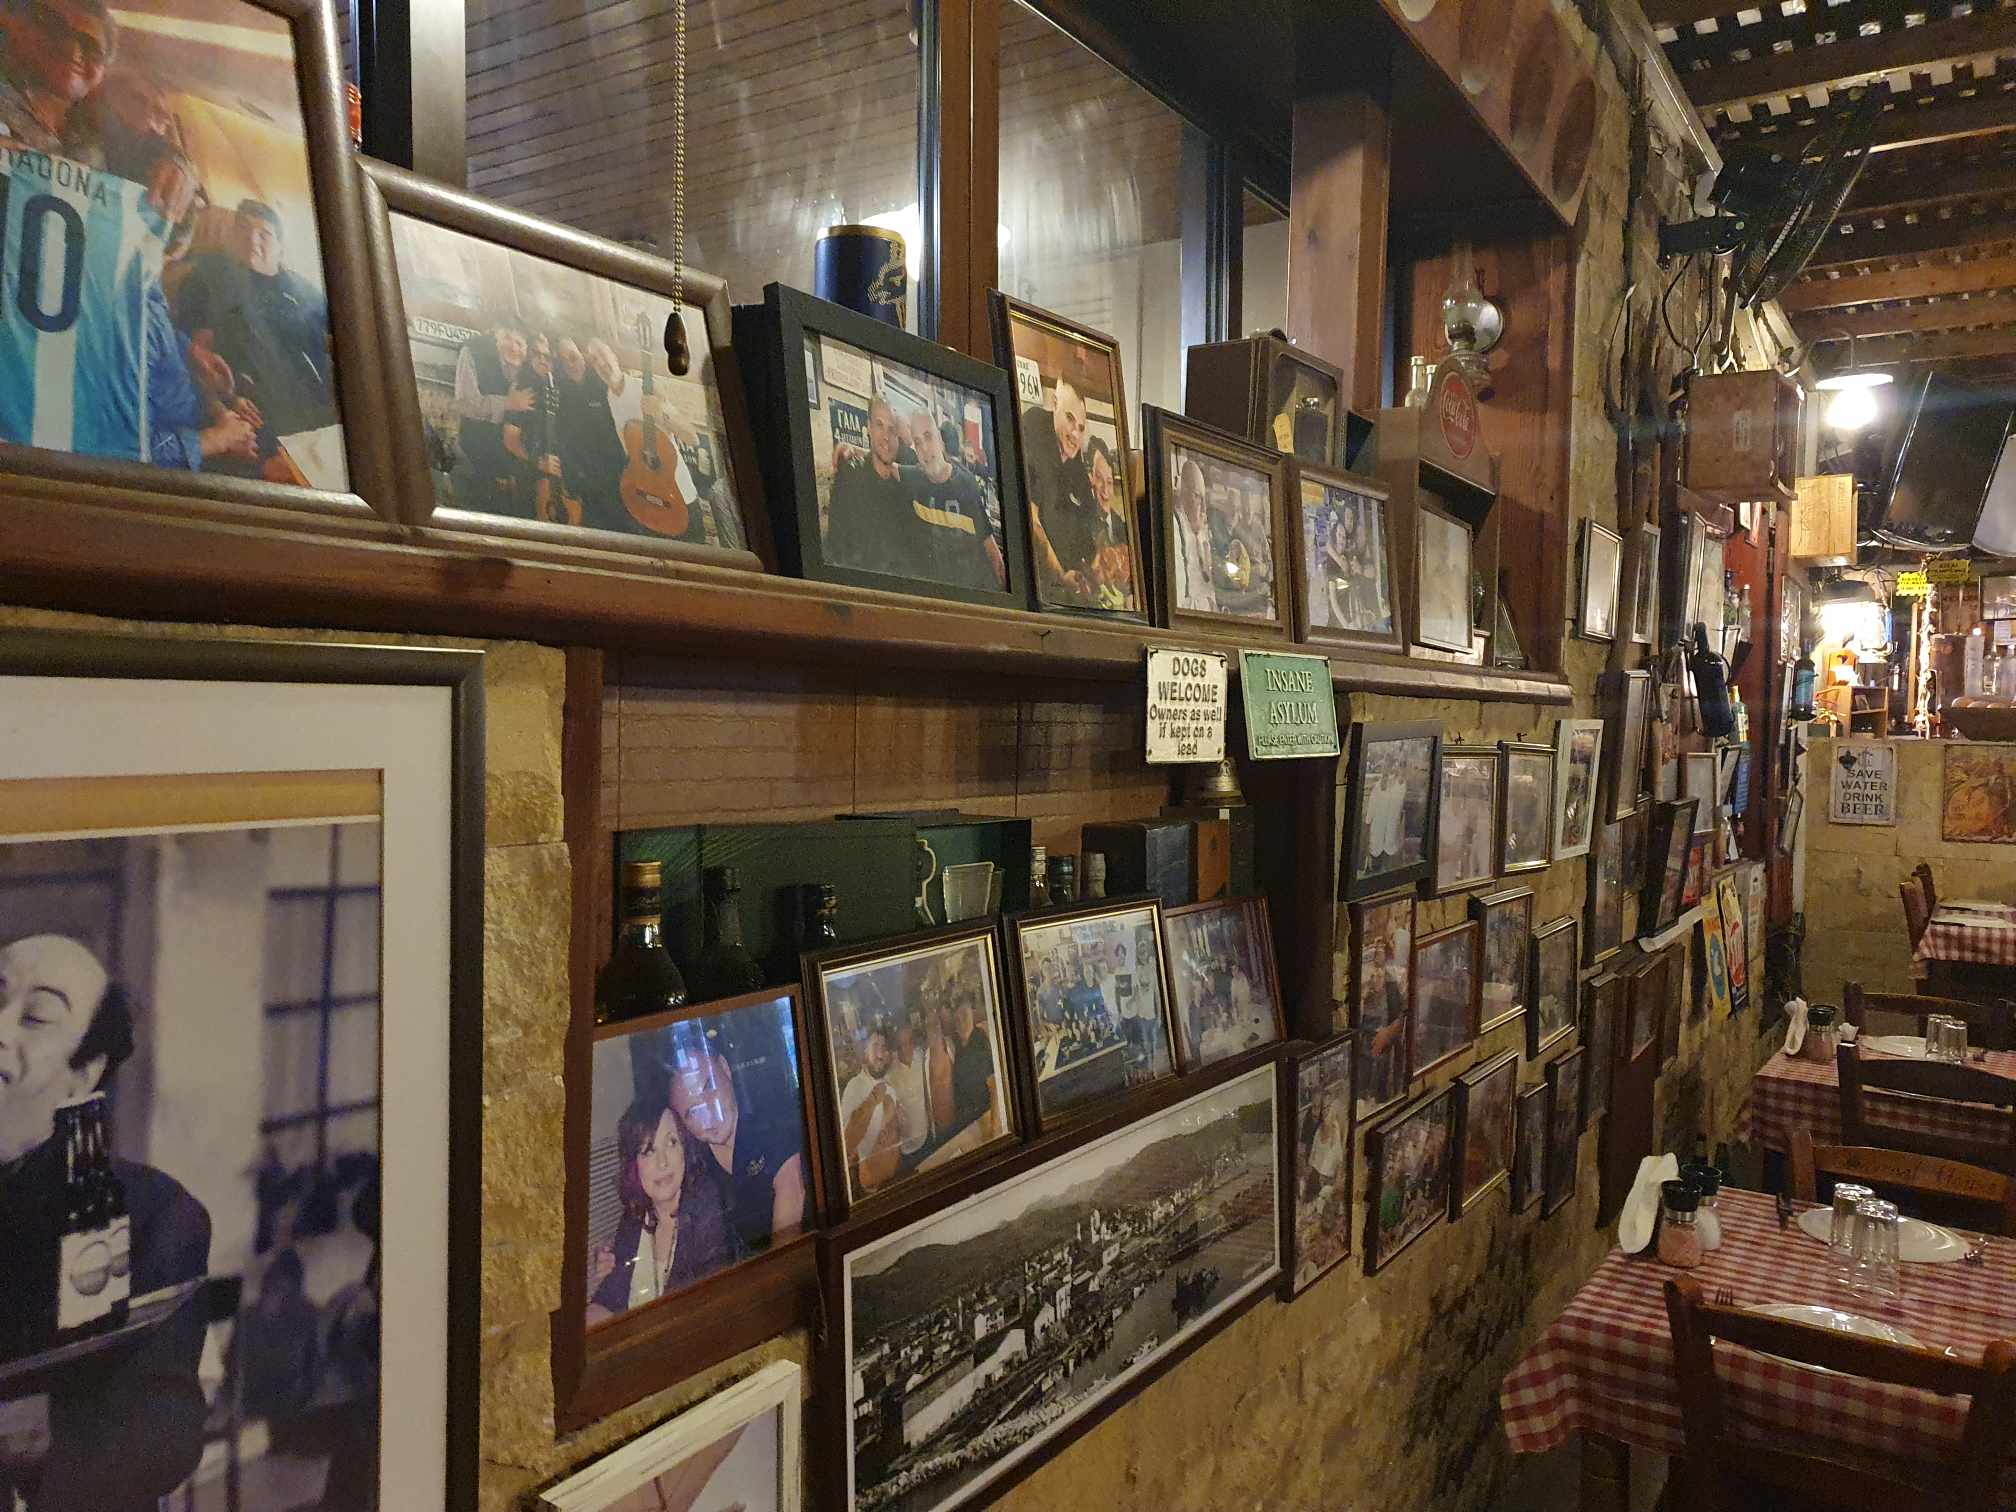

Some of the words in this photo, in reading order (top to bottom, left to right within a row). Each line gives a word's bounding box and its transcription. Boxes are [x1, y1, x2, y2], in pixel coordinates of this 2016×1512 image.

[1172, 656, 1207, 678] DOGS
[1265, 667, 1314, 694] INSANE
[1158, 681, 1219, 703] WELCOME
[1150, 703, 1188, 720] Owners
[1190, 708, 1201, 721] as
[1203, 706, 1222, 721] well
[1269, 701, 1319, 726] ASYLUM
[1159, 721, 1167, 739] if
[1170, 722, 1191, 741] kept
[1193, 726, 1205, 738] on
[1207, 726, 1213, 738] a
[1177, 740, 1198, 756] lead
[1847, 769, 1881, 779] SAVE
[1841, 780, 1888, 791] WATER
[1843, 792, 1883, 803] DRINK
[1840, 803, 1885, 815] BEER
